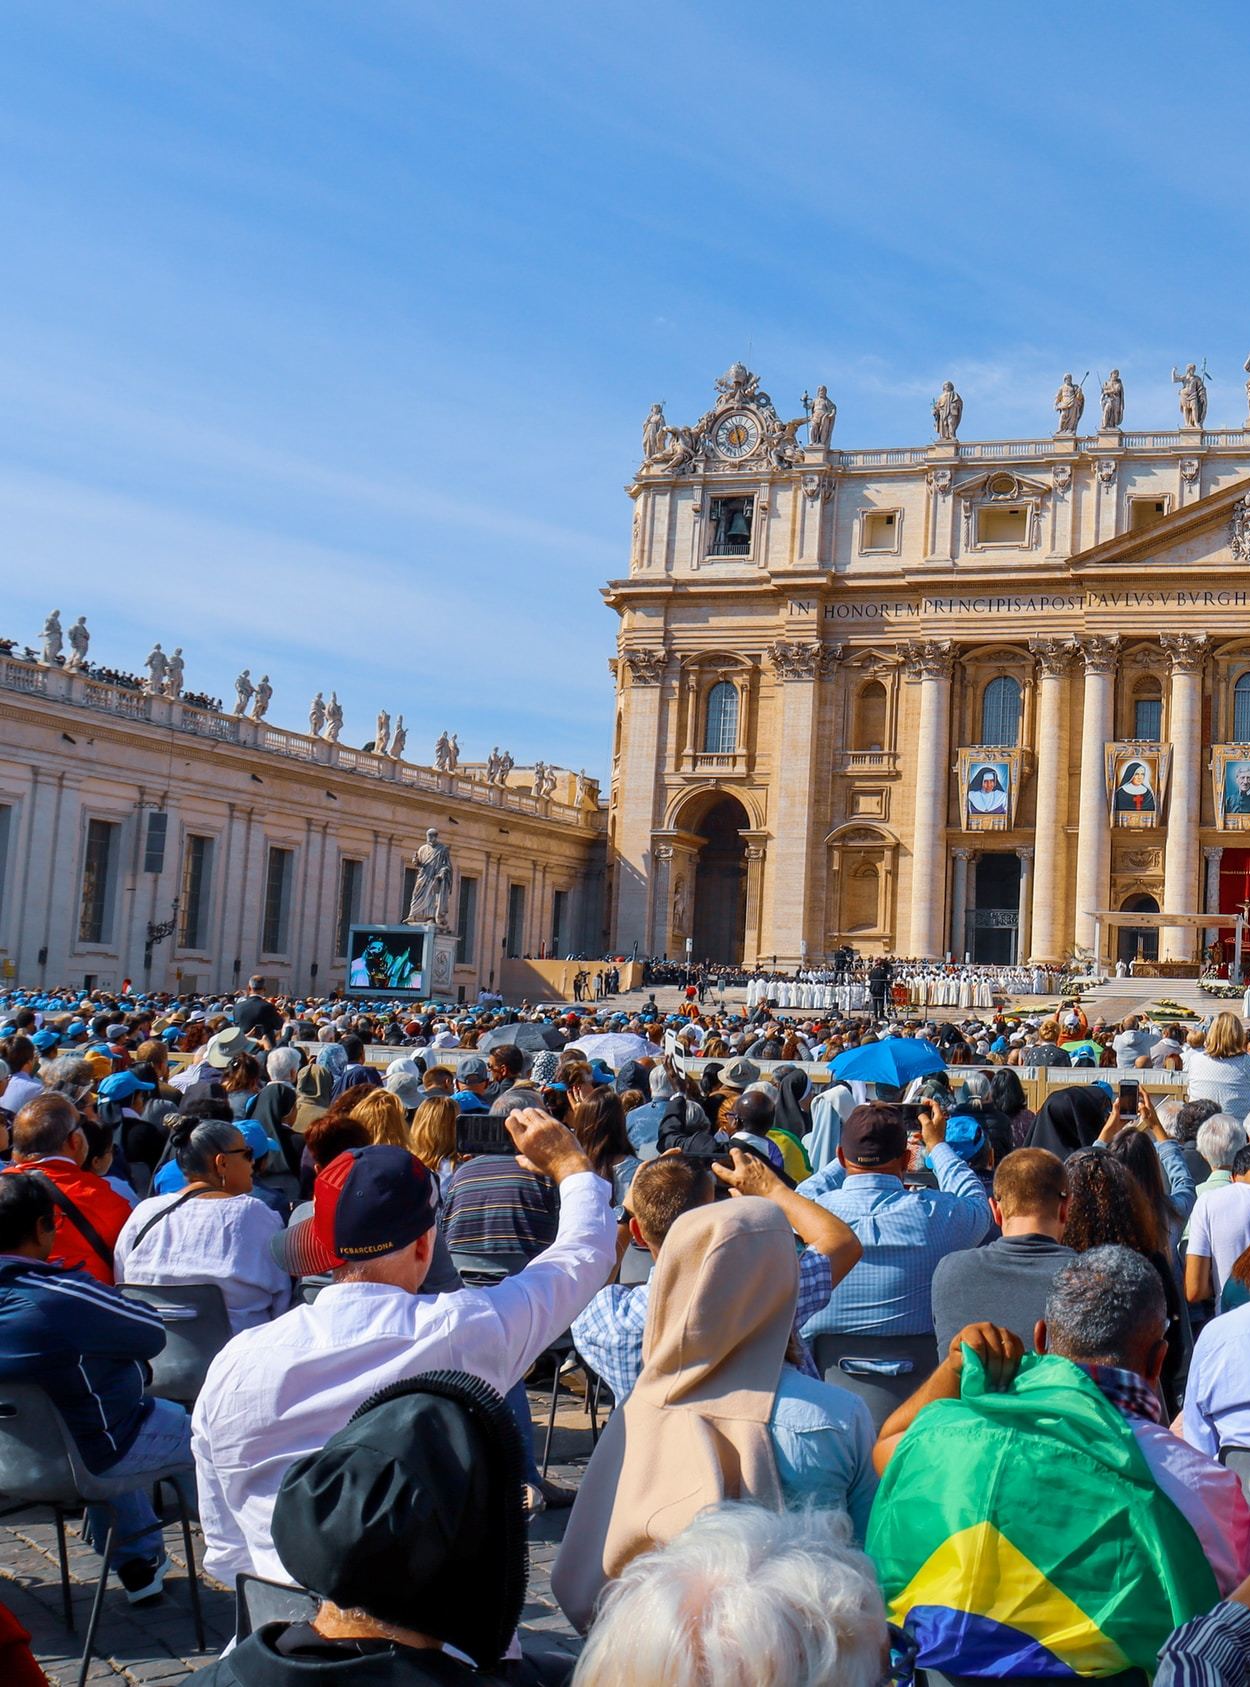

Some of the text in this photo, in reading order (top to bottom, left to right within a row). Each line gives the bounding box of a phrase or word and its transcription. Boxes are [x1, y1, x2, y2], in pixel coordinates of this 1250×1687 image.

[789, 602, 811, 616] IN
[824, 603, 920, 619] HONOREM
[923, 598, 1022, 614] PRINCIPIS
[1025, 596, 1087, 611] APOST
[1088, 592, 1155, 607] PAVLVS
